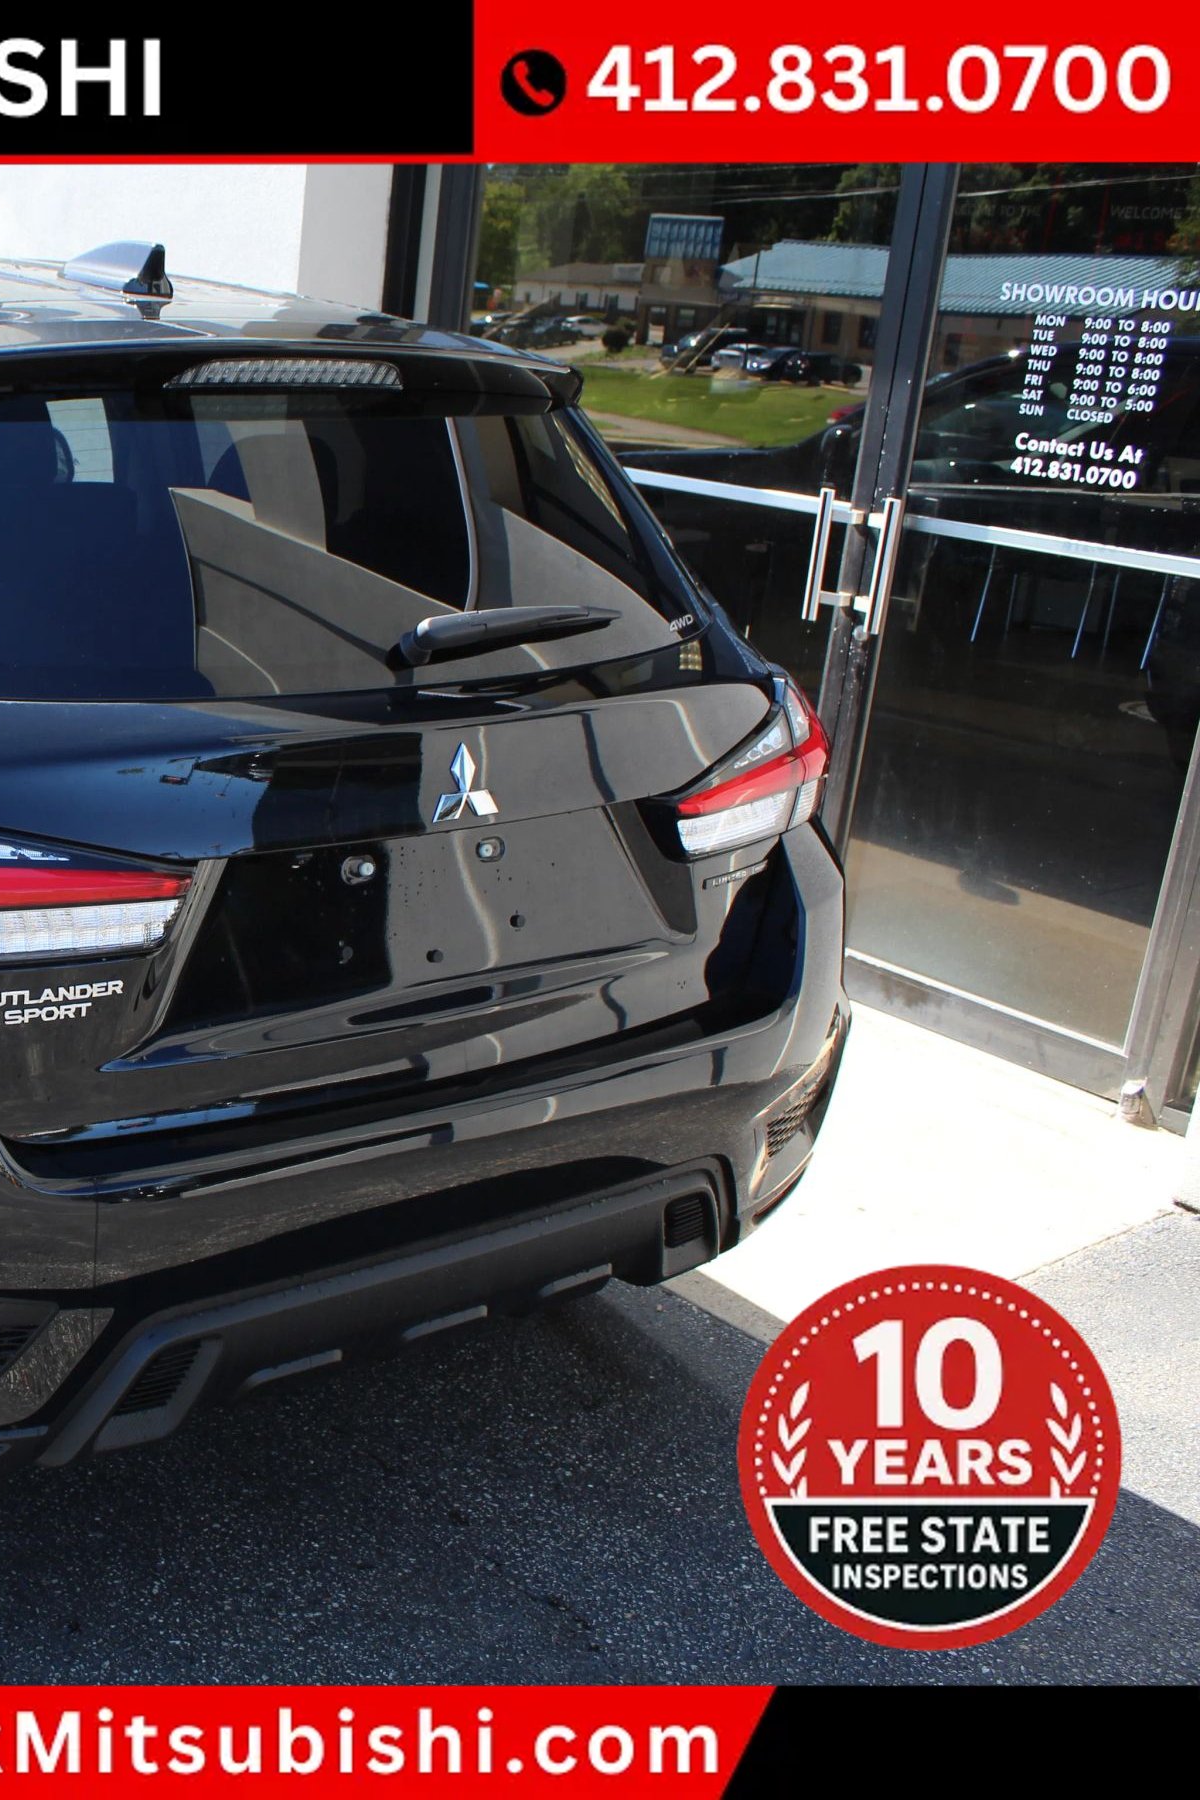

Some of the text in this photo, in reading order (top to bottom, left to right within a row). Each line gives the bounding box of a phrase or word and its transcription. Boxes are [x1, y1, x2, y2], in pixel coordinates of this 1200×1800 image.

[1110, 204, 1182, 220] WELCOME
[1000, 282, 1134, 308] SHOWROOM
[1035, 314, 1171, 334] MON 9:00 TO 8:00
[1032, 329, 1167, 350] TUE 9:00 TO 8:00
[1030, 344, 1164, 366] WED 9:00 TO 8:00
[1027, 359, 1160, 381] THU 9:00 TO 8:00
[1024, 374, 1157, 397] FRI 9:00 TO 6:00
[1021, 389, 1154, 413] SAT 9:00 TO 5:00
[1018, 403, 1114, 424] SUN CLOSED
[1015, 432, 1144, 464] Contact Us At
[1009, 456, 1137, 489] 412.831.0700
[669, 613, 694, 632] 4WD
[4, 1002, 93, 1026] SPORT
